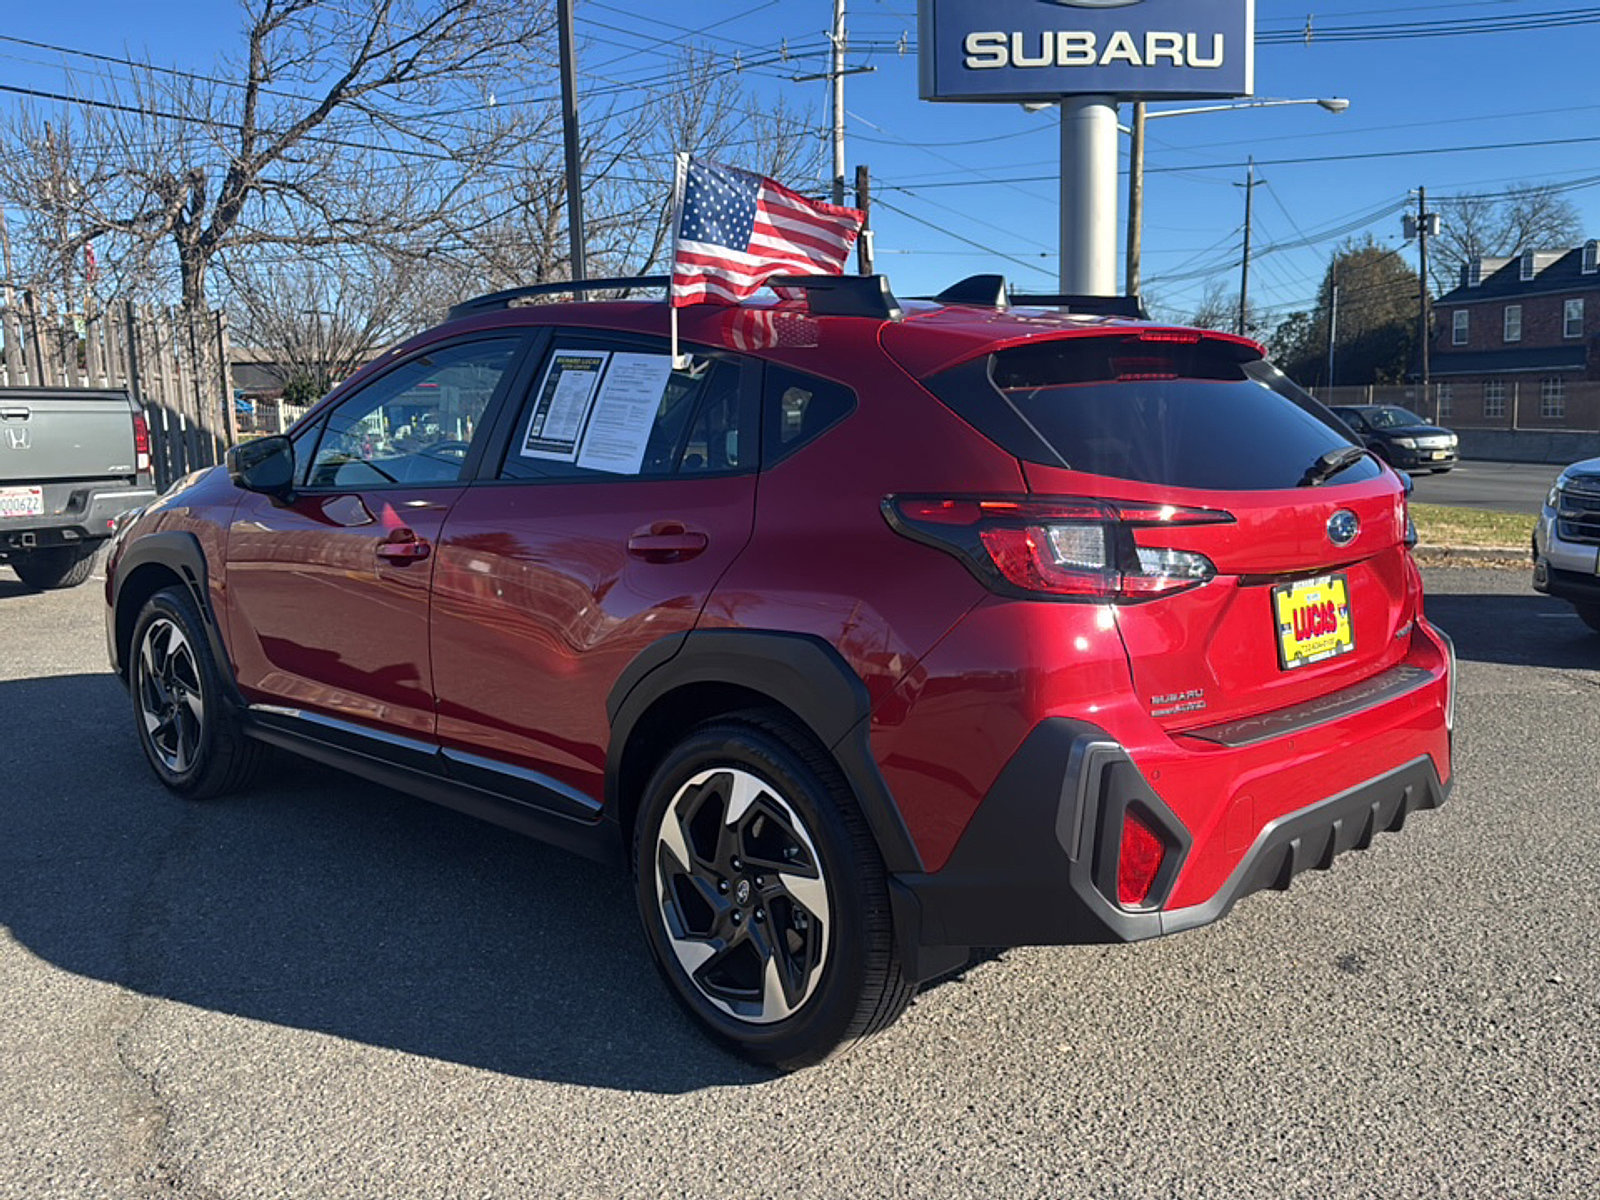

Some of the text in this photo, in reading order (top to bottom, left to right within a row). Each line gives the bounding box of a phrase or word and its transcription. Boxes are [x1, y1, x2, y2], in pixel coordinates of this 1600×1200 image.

[965, 31, 1224, 68] SUBARU
[1293, 600, 1337, 641] LUCAS
[1151, 689, 1204, 704] SUBARU
